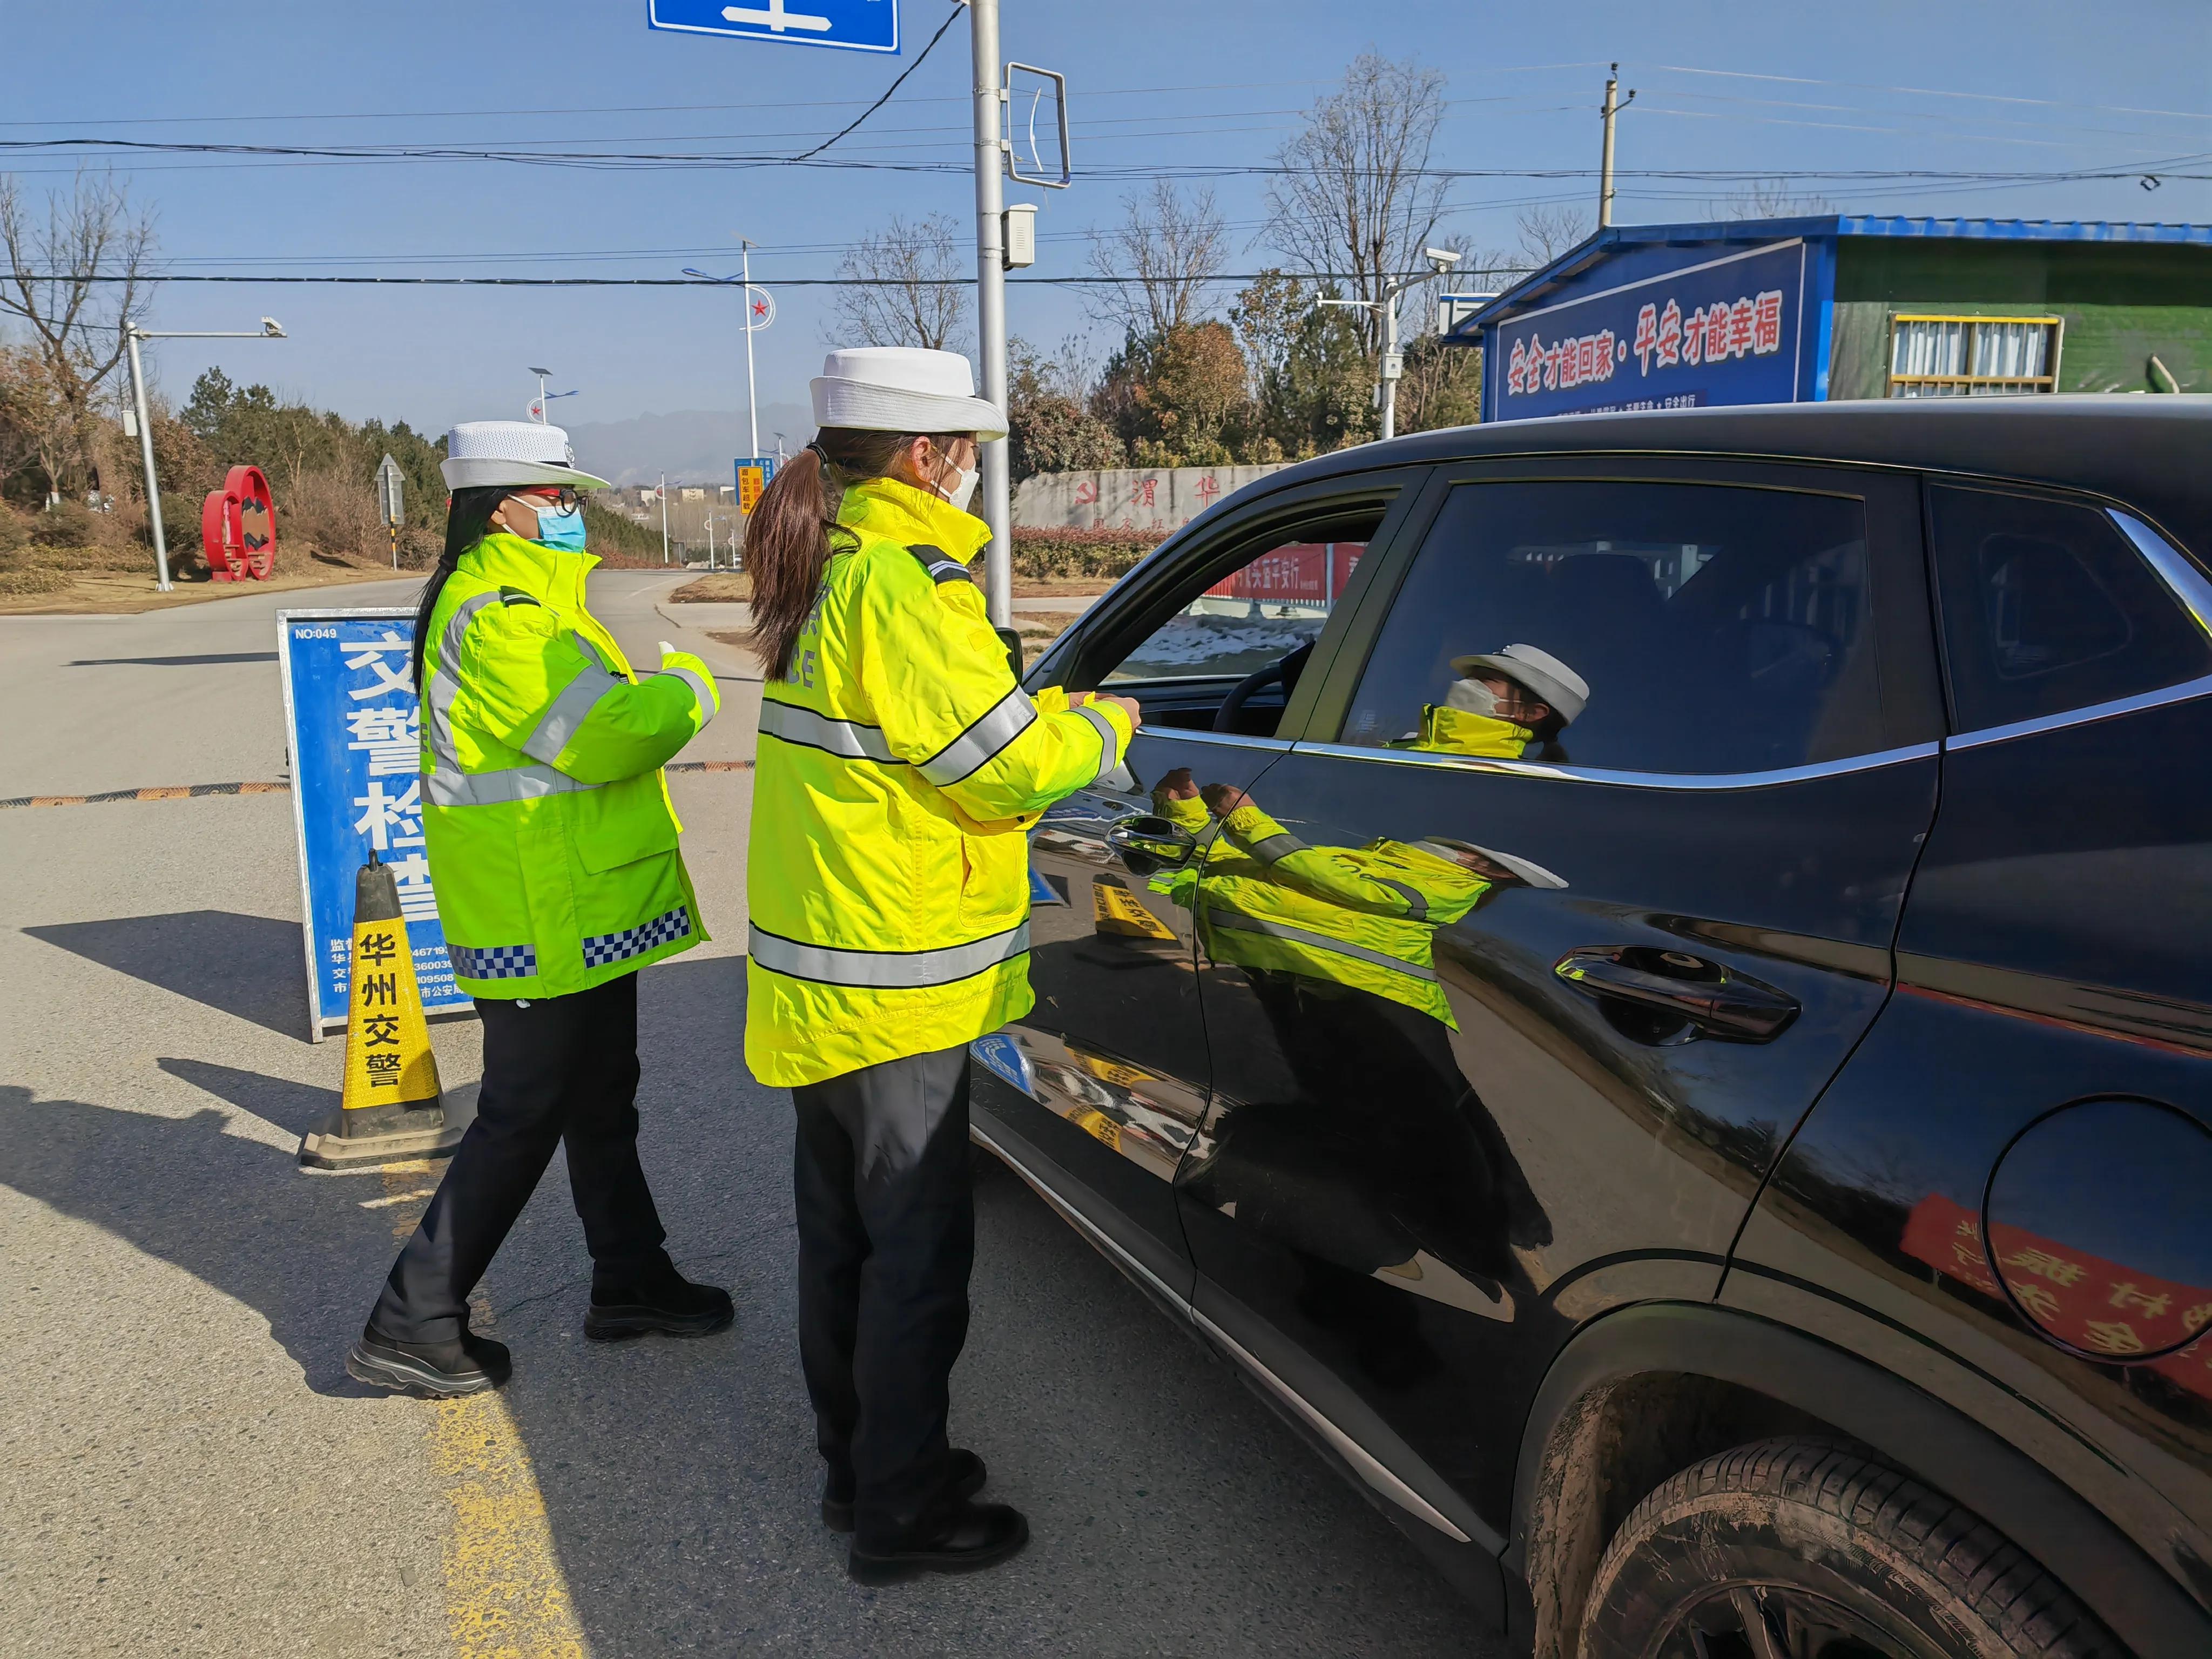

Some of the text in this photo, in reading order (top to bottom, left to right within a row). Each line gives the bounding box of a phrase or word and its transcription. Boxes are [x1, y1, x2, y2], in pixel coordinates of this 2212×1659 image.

[295, 629, 337, 639] NO:049
[359, 933, 402, 1088] 华州交警
